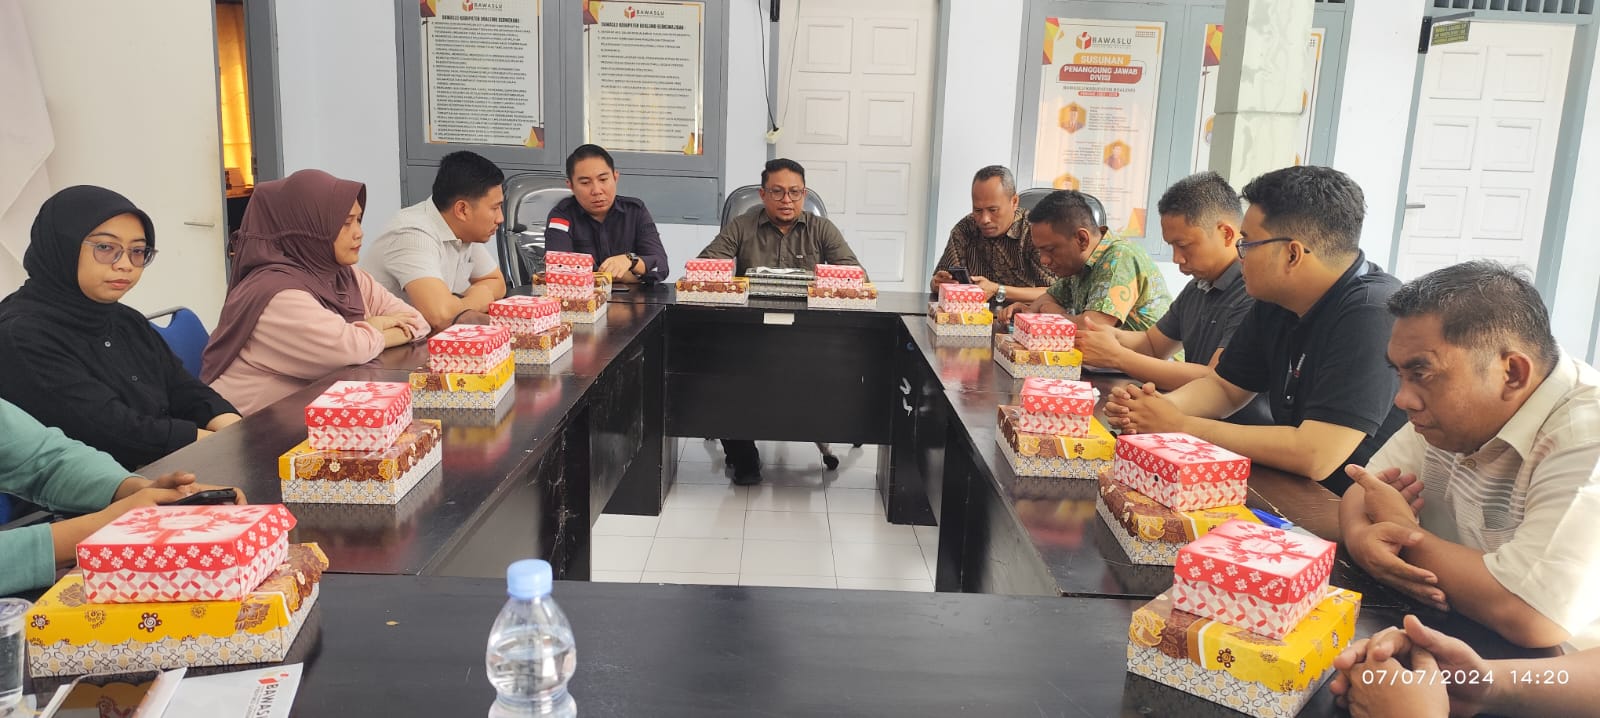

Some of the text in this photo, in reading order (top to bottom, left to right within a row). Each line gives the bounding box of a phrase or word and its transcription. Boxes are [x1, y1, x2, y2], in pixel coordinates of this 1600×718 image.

[1092, 37, 1132, 45] BAWASLU
[1080, 55, 1124, 65] SUSUNAN
[1064, 65, 1112, 74] PENANGGUNG
[256, 684, 279, 718] BAWAS
